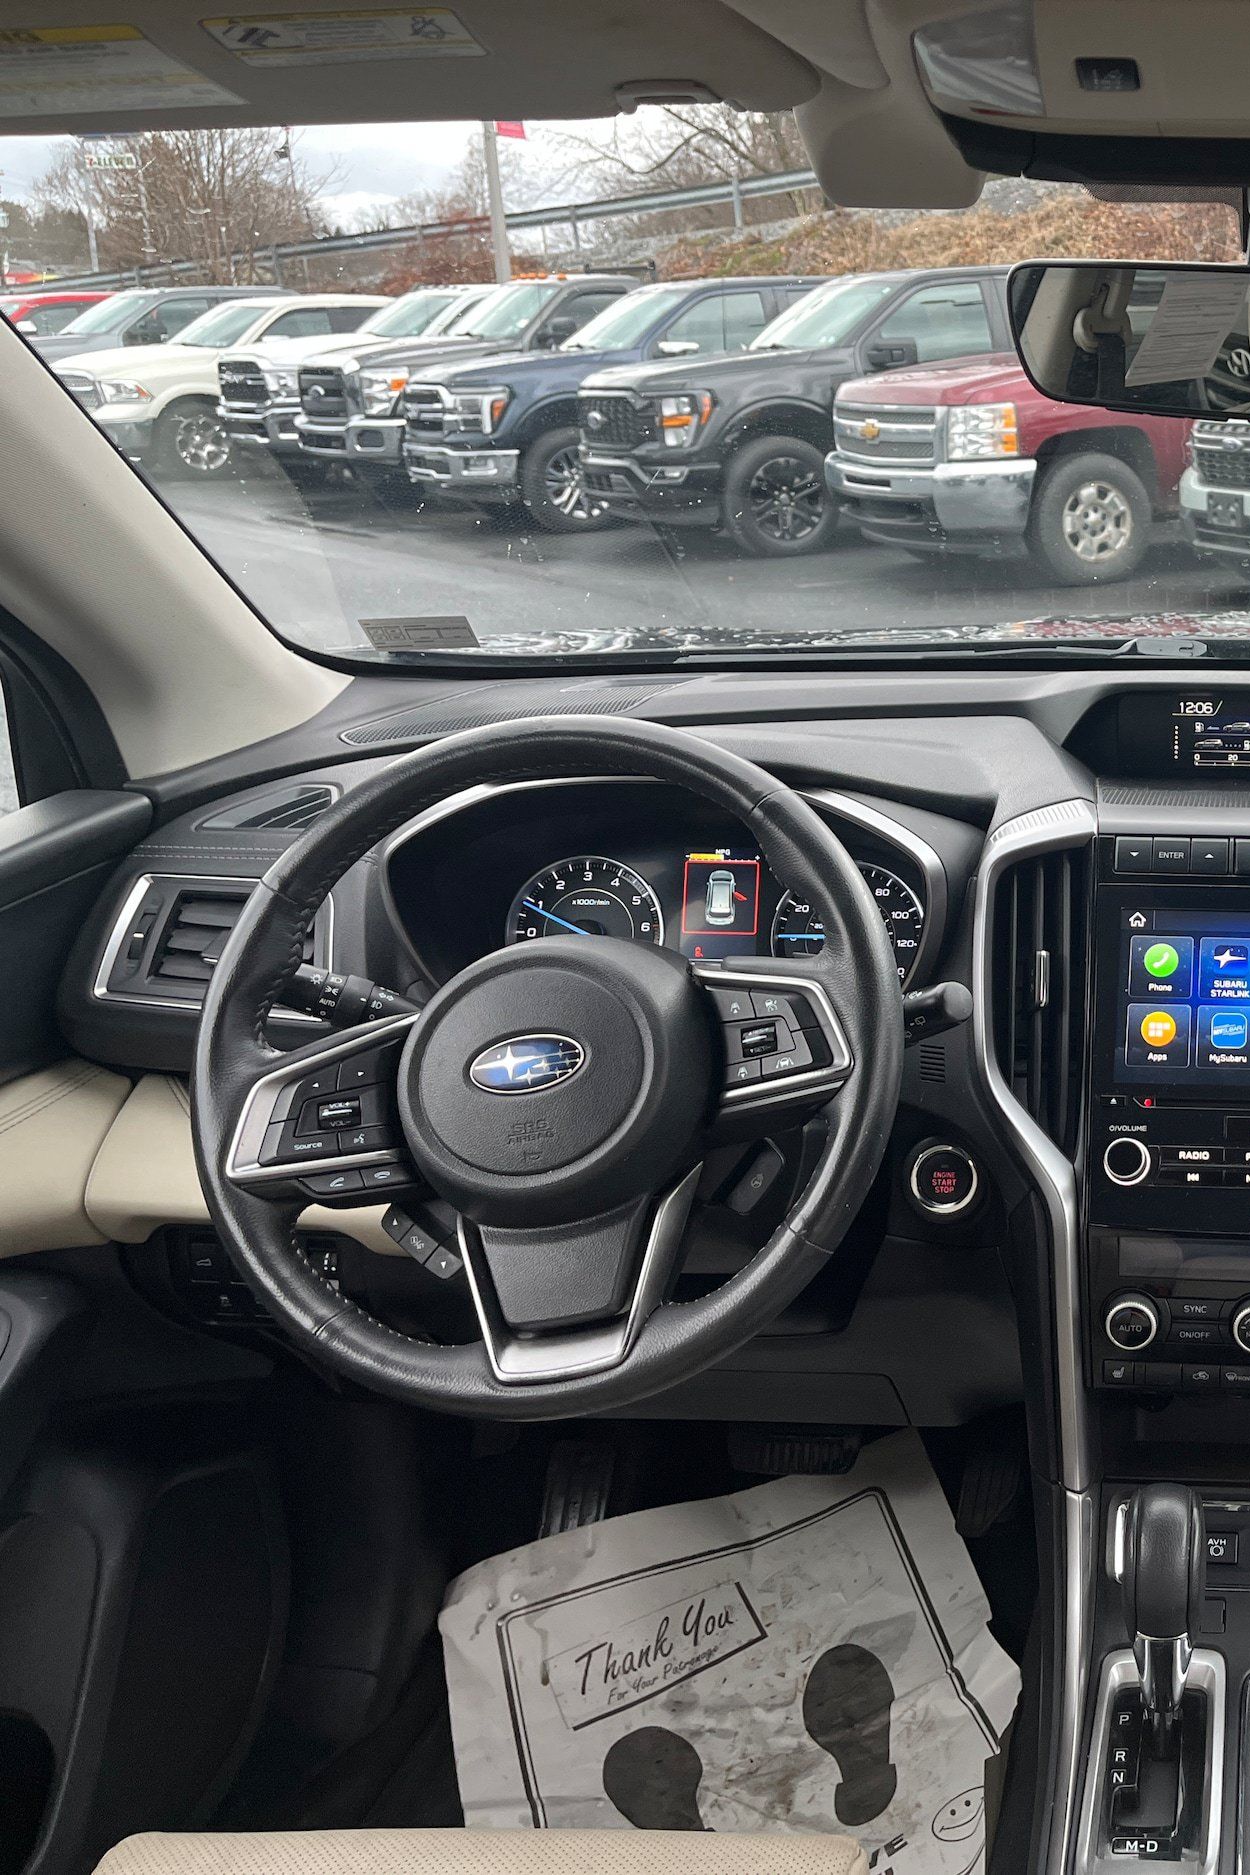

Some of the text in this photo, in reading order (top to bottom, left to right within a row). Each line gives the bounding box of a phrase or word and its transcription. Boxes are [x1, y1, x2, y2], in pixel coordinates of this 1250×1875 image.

[1178, 702, 1213, 715] 12:06
[1194, 753, 1200, 761] 0
[1228, 753, 1239, 761] 20
[1158, 851, 1184, 860] ENTER
[583, 871, 593, 881] 3
[555, 880, 566, 890] 2
[610, 877, 620, 887] 4
[875, 888, 890, 897] 80
[537, 900, 543, 910] 1
[632, 895, 642, 905] 5
[794, 904, 810, 913] 20
[891, 911, 909, 920] 100
[640, 922, 651, 932] 6
[526, 927, 537, 938] 0
[896, 940, 914, 948] 120
[1148, 983, 1173, 992] Phone
[1213, 980, 1248, 989] SUBARU
[1210, 989, 1250, 998] STARLINK
[319, 997, 336, 1008] AUTO
[1147, 1052, 1168, 1062] Apps
[1208, 1053, 1248, 1064] MySubaru
[293, 1141, 323, 1151] Source
[1178, 1150, 1210, 1160] RADIO
[931, 1178, 957, 1186] START
[934, 1186, 955, 1194] STOP
[1183, 1304, 1208, 1313] SYNC
[1119, 1324, 1143, 1333] AUTO
[1179, 1331, 1211, 1339] ON/OFF
[1207, 1538, 1228, 1546] AVH
[574, 1598, 734, 1695] Thank You
[607, 1687, 628, 1705] For
[632, 1675, 659, 1694] Your
[1119, 1714, 1130, 1726] P
[1115, 1751, 1126, 1762] R
[1112, 1771, 1124, 1783] N
